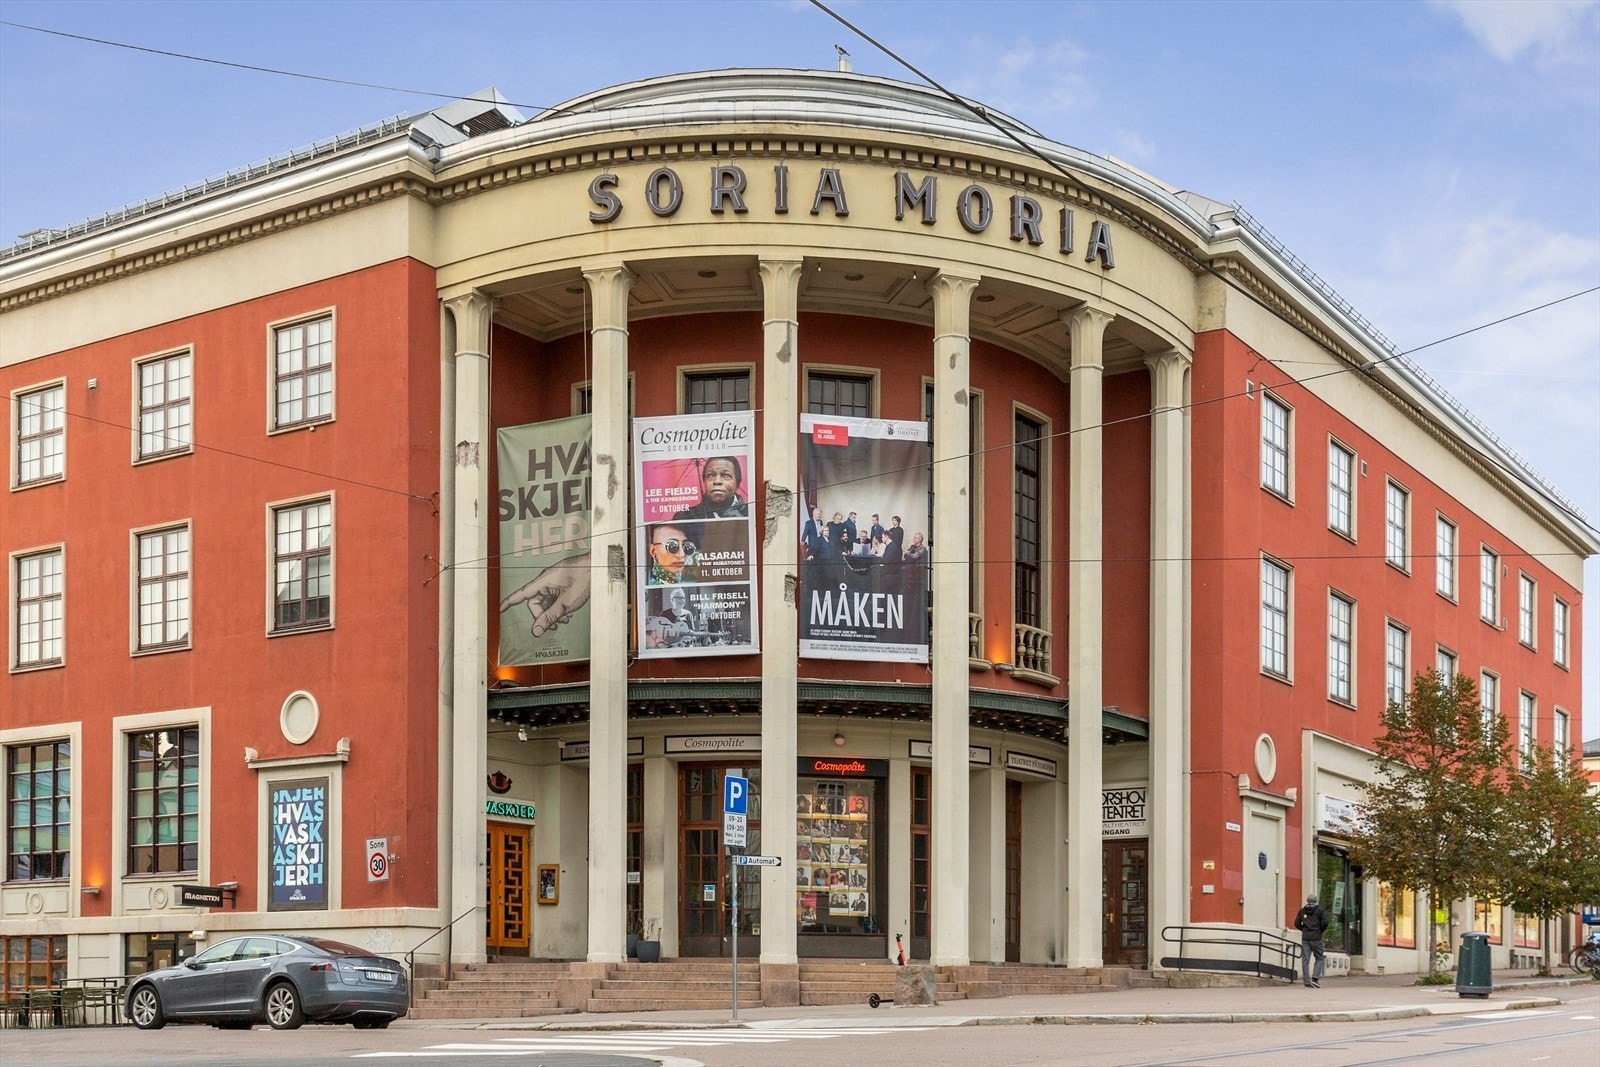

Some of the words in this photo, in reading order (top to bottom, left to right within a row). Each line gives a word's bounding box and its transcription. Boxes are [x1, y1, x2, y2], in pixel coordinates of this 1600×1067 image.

[588, 165, 849, 224] SORIA
[894, 171, 1116, 270] MORIA
[641, 420, 748, 450] Cosmopolite
[527, 440, 592, 481] HVA
[645, 488, 662, 497] LEE
[665, 486, 698, 496] FIELDS
[659, 504, 690, 513] OKTOBER
[513, 515, 588, 558] HER
[698, 551, 745, 560] ALSARAH
[701, 569, 710, 577] 11.
[712, 567, 743, 577] OKTOBER
[690, 593, 710, 601] BILL
[712, 592, 748, 600] FRISELL
[810, 582, 904, 629] MÅKEN
[710, 611, 741, 620] OKTOBER
[535, 649, 569, 658] HVASKJER
[684, 738, 745, 750] Cosmopolite
[814, 760, 866, 775] Cosmopolite
[730, 782, 742, 808] P
[1102, 790, 1146, 805] ORSHOV
[486, 801, 535, 819] VASKJER
[369, 841, 385, 849] Sone
[372, 859, 384, 872] 30
[749, 857, 775, 865] Automat
[184, 892, 220, 902] MAGNETEN
